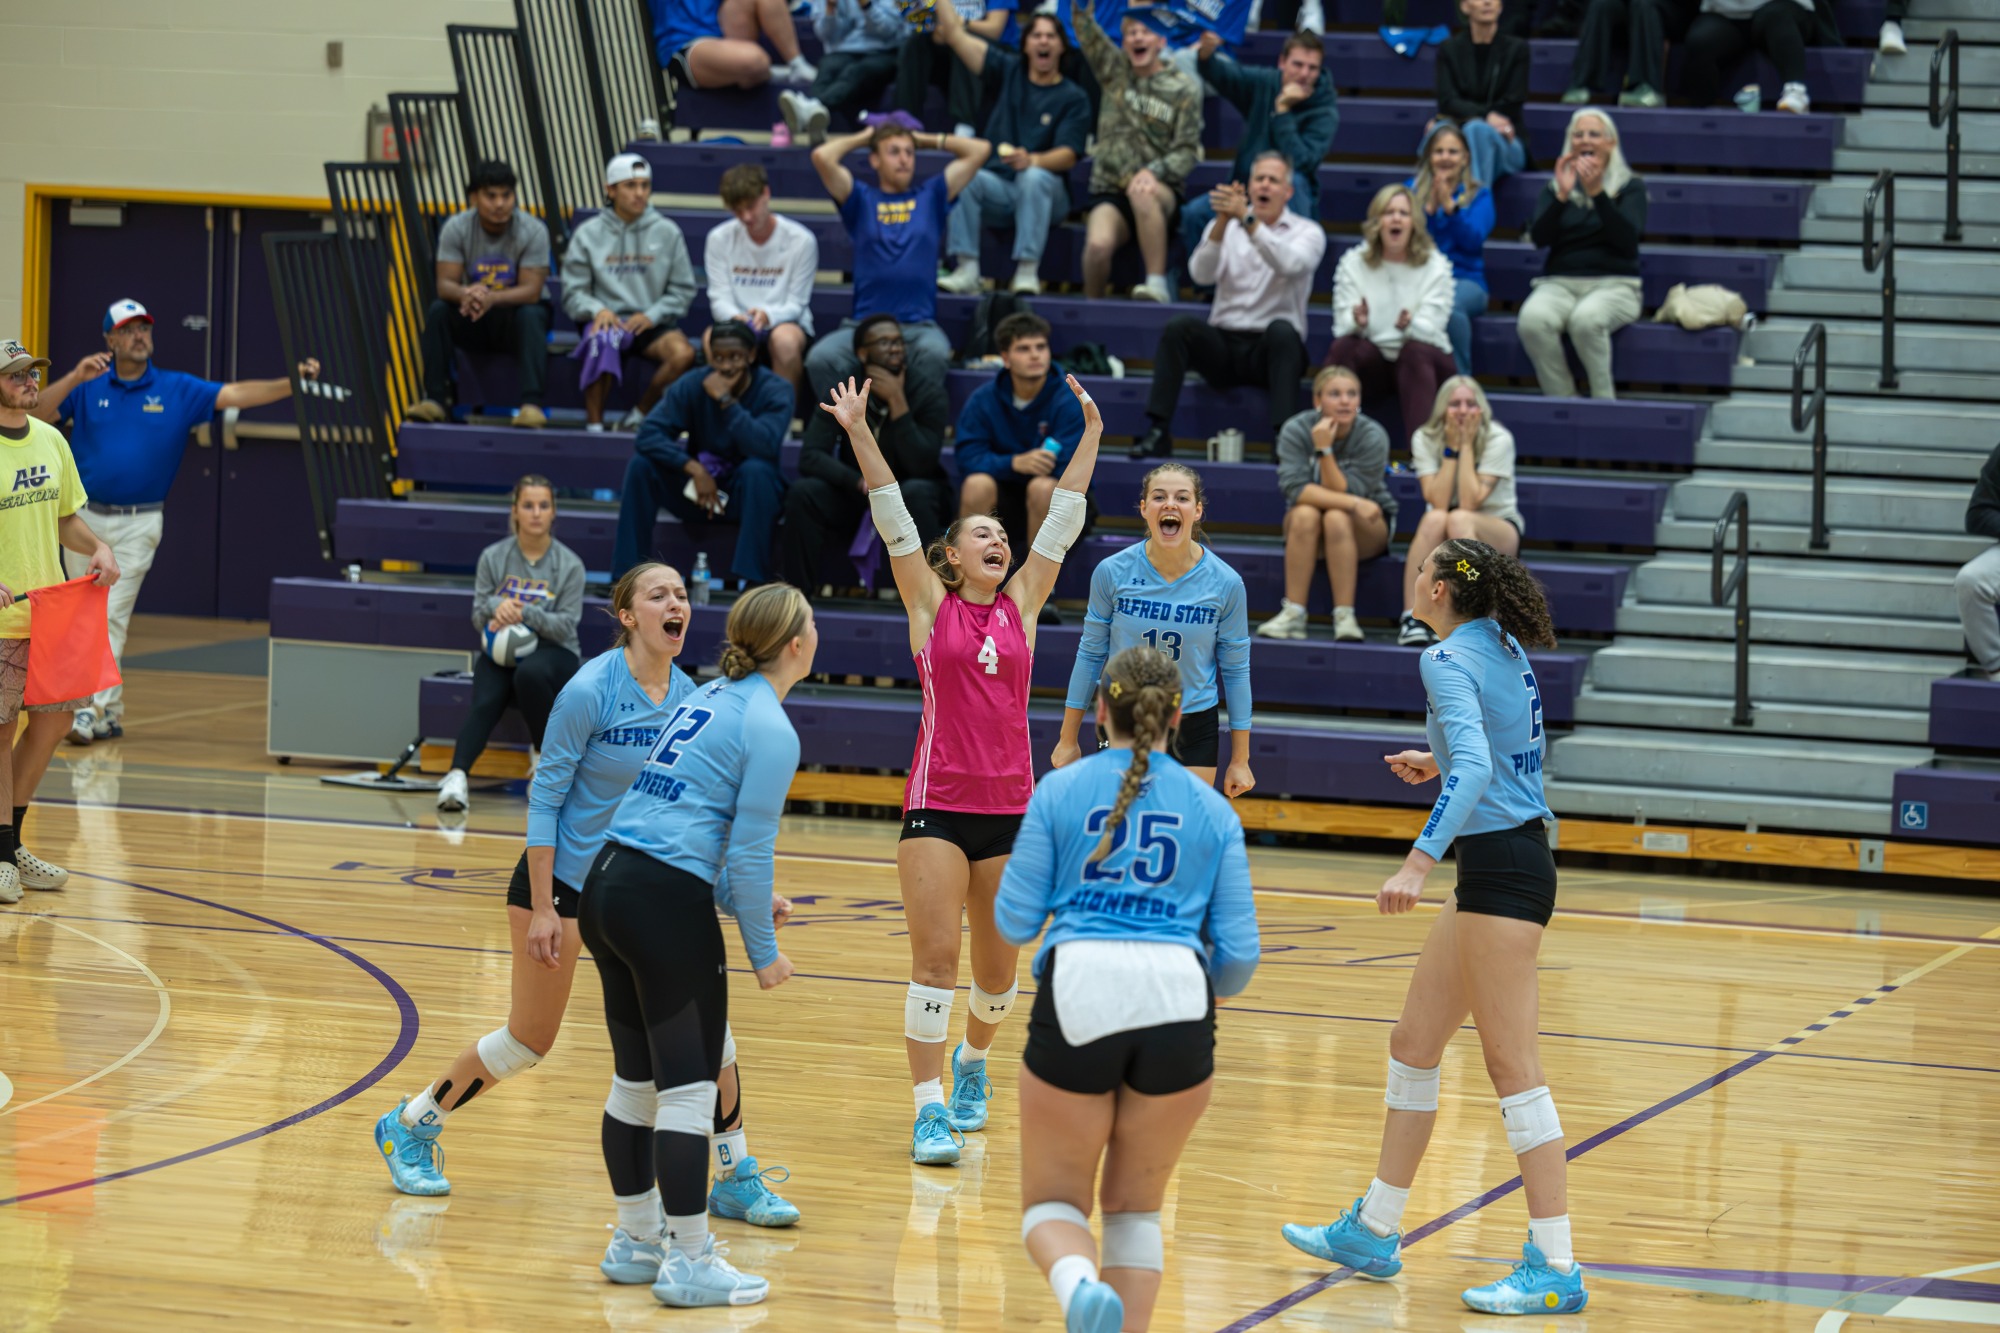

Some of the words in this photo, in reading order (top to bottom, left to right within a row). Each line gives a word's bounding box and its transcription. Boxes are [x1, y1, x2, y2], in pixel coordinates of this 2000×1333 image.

[12, 465, 50, 492] AU
[1117, 597, 1171, 621] ALFRED
[1174, 604, 1216, 624] STATE
[977, 635, 999, 674] 4
[1141, 627, 1183, 662] 13
[644, 704, 715, 769] 12
[1510, 747, 1542, 777] PION
[1445, 775, 1460, 791] OX
[1422, 793, 1451, 838] STRONG
[1080, 805, 1183, 887] 25
